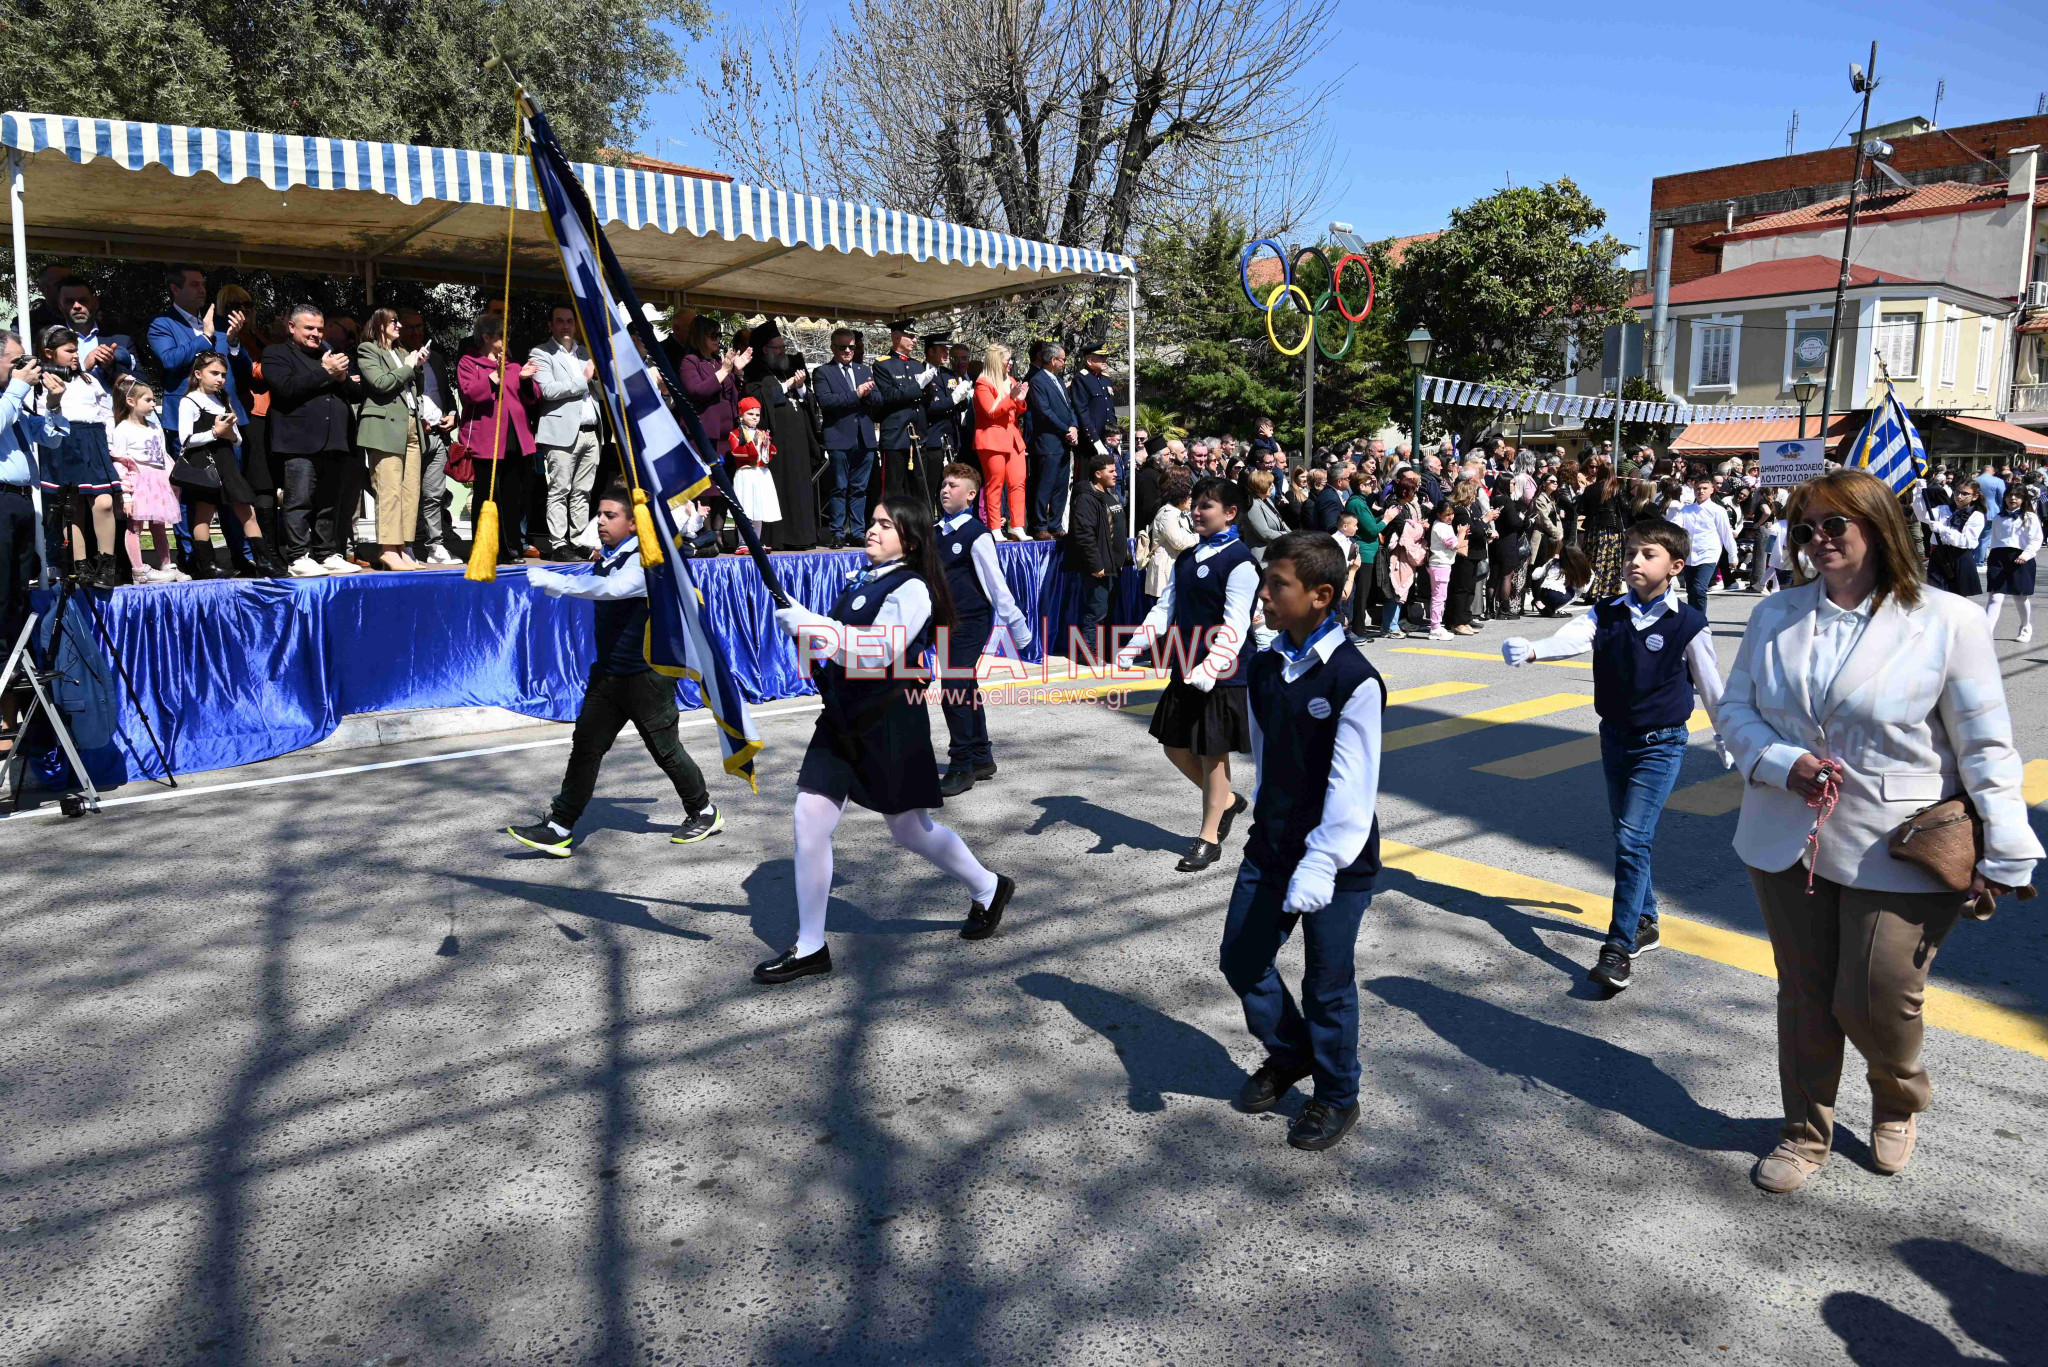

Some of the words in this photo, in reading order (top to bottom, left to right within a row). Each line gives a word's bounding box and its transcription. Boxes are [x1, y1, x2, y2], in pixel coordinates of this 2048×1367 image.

[1760, 464, 1793, 473] ΔΗΜΟΤΙΚΟ
[1795, 463, 1823, 471] ΣΧΟΛΕΙΟ
[1760, 473, 1823, 483] ΛΟΥΤΡΟΧΩΡΙ
